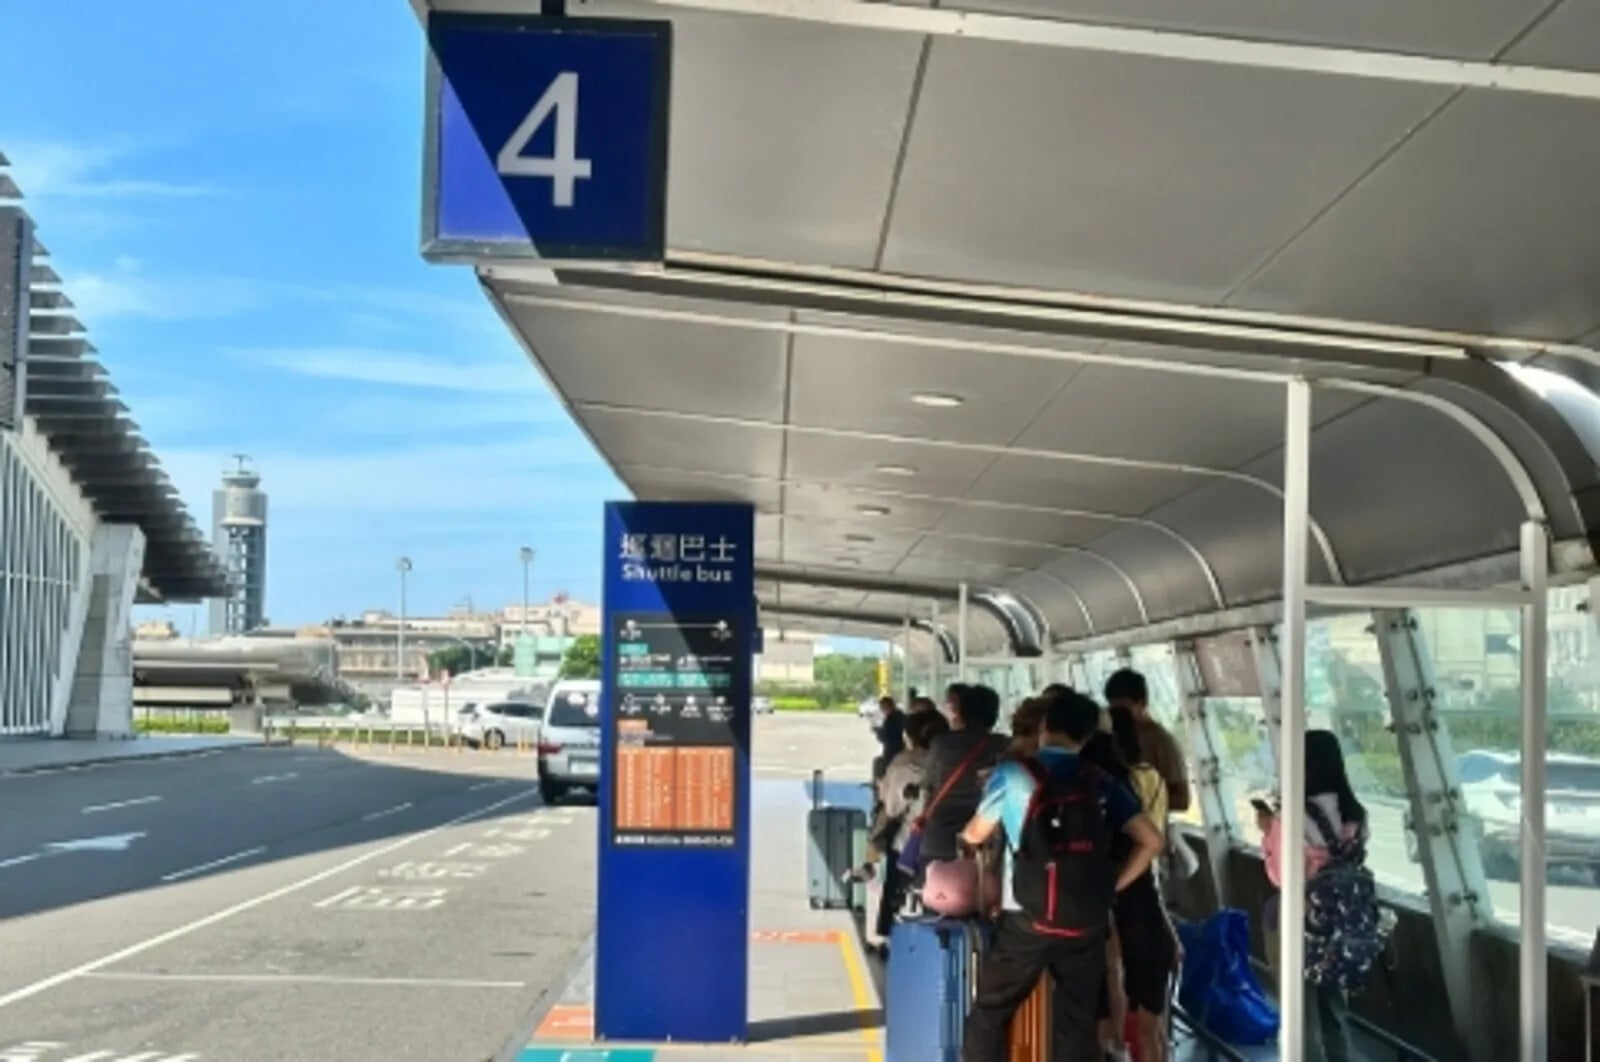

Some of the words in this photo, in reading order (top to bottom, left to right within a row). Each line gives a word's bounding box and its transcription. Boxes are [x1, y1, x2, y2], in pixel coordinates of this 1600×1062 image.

[497, 72, 592, 207] 4
[622, 563, 692, 582] Shuttle
[696, 563, 733, 582] bus
